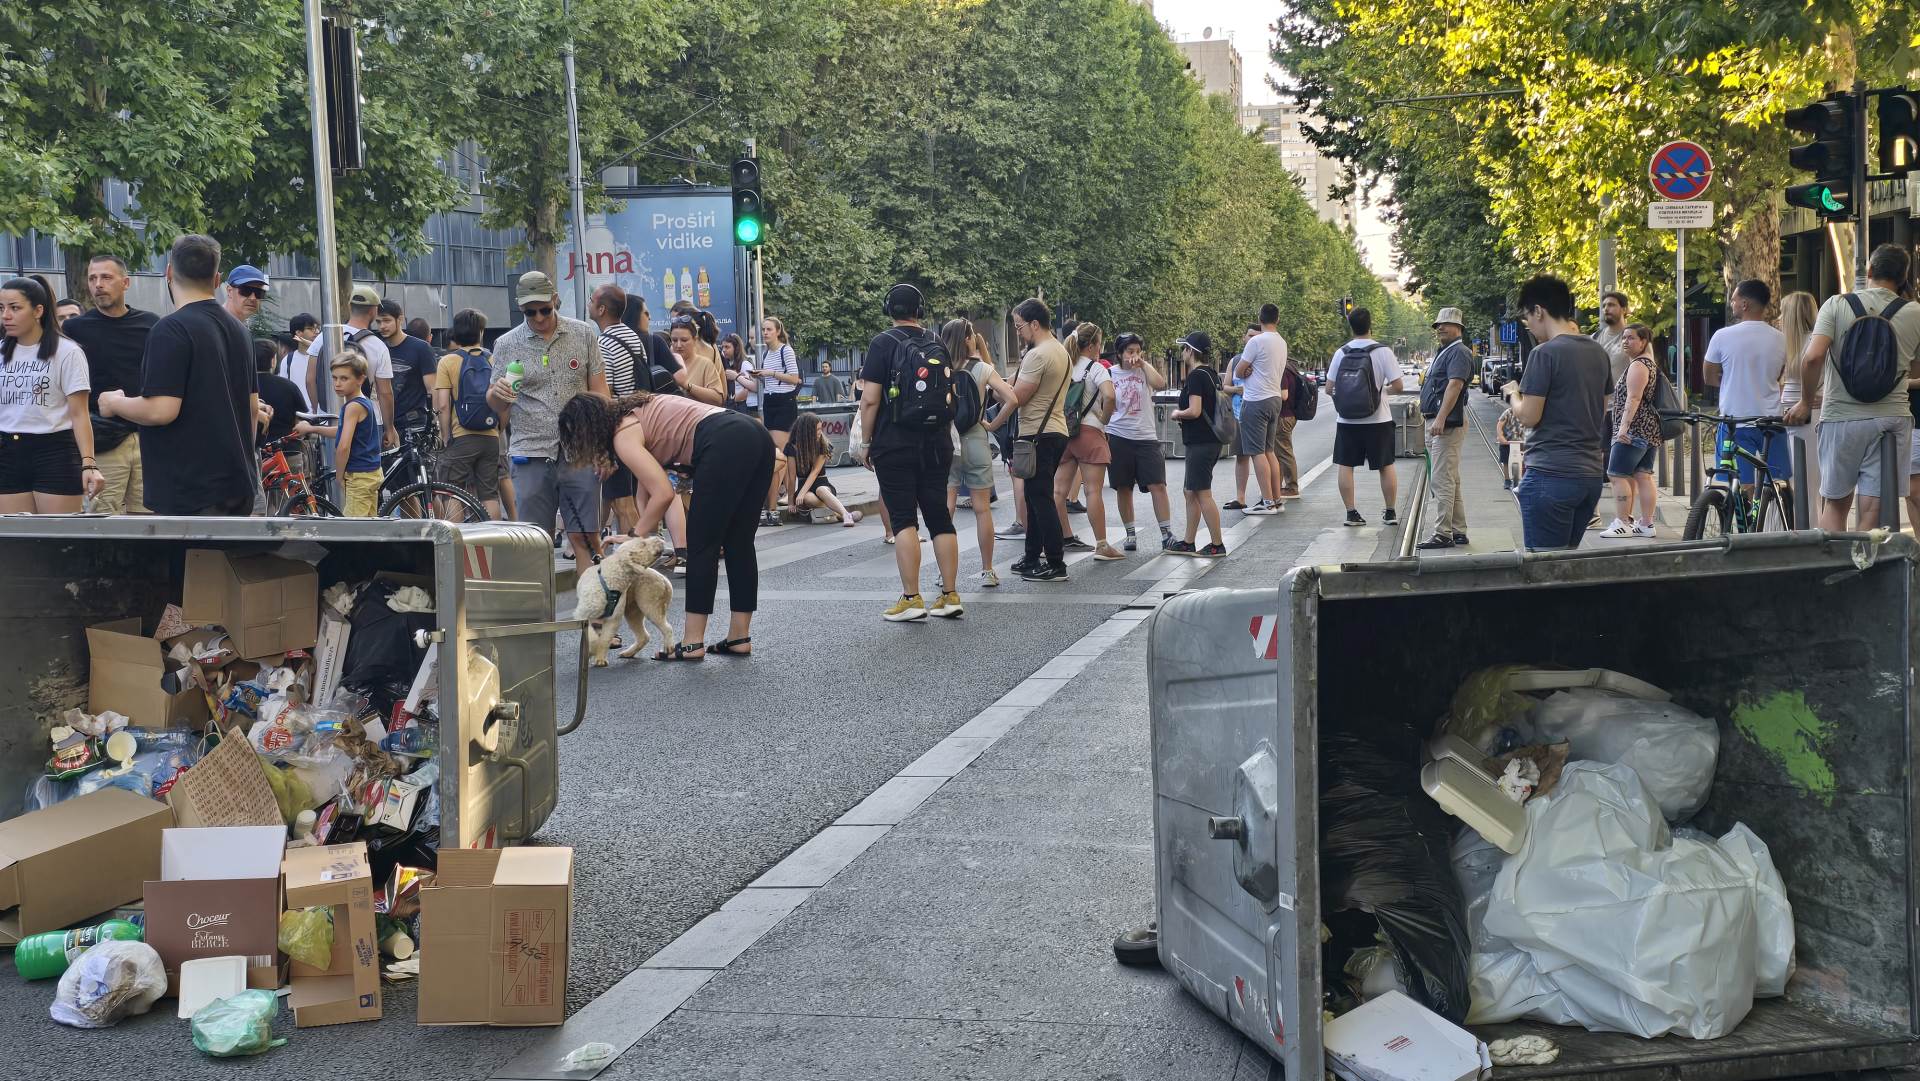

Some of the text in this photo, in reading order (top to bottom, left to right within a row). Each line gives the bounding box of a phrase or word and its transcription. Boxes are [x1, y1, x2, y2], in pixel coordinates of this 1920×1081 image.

[652, 210, 716, 230] Proširi
[656, 231, 713, 250] vidike
[186, 912, 232, 929] Choceur
